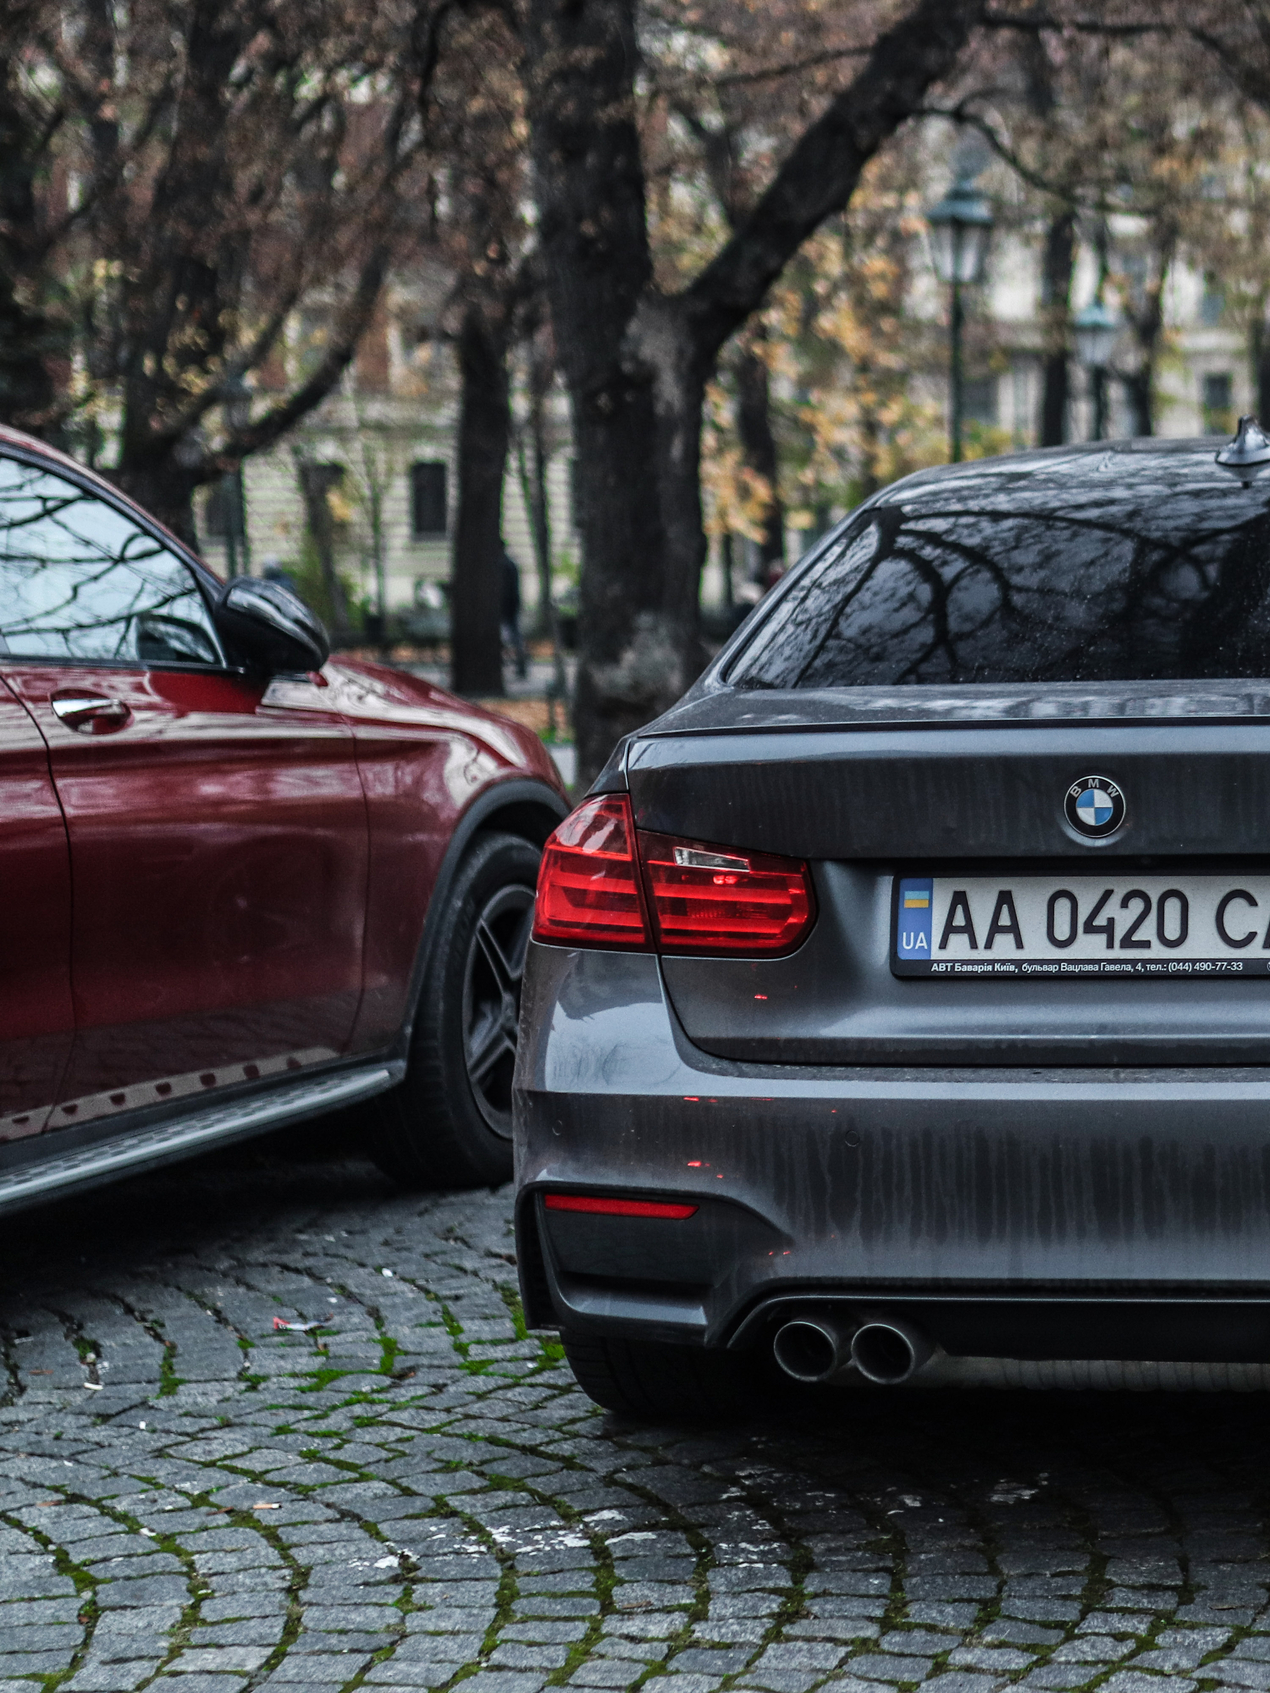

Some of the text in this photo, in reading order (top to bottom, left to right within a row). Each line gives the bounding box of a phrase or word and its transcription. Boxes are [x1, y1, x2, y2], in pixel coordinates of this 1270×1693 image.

[1069, 778, 1120, 798] BMW
[938, 890, 1024, 950] AA
[1046, 889, 1189, 949] 0420
[902, 932, 928, 950] UA
[931, 962, 1243, 973] АВТ Баварія Київ, бульвар Вацлава Гавела, 4, тел.: (044) 490-77-33
